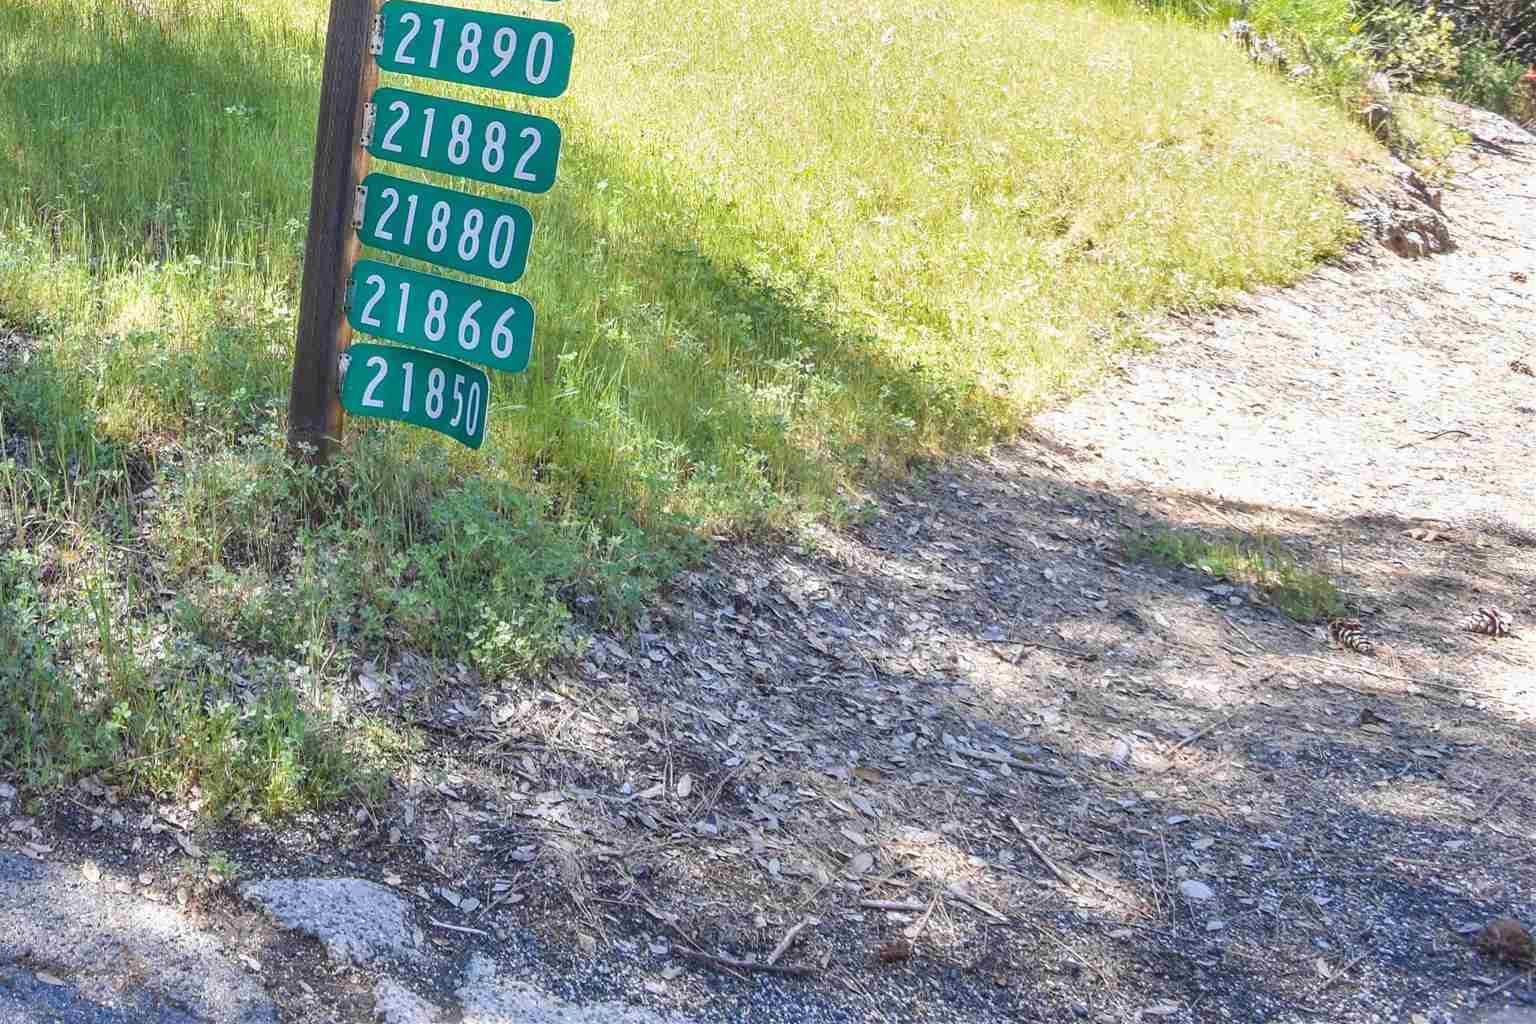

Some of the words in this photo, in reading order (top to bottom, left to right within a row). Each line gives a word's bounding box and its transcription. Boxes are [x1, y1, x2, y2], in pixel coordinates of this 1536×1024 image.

[394, 12, 553, 85] 21890
[382, 100, 542, 182] 21882
[374, 187, 515, 269] 21880
[360, 274, 515, 359] 21866
[362, 355, 481, 437] 21850
